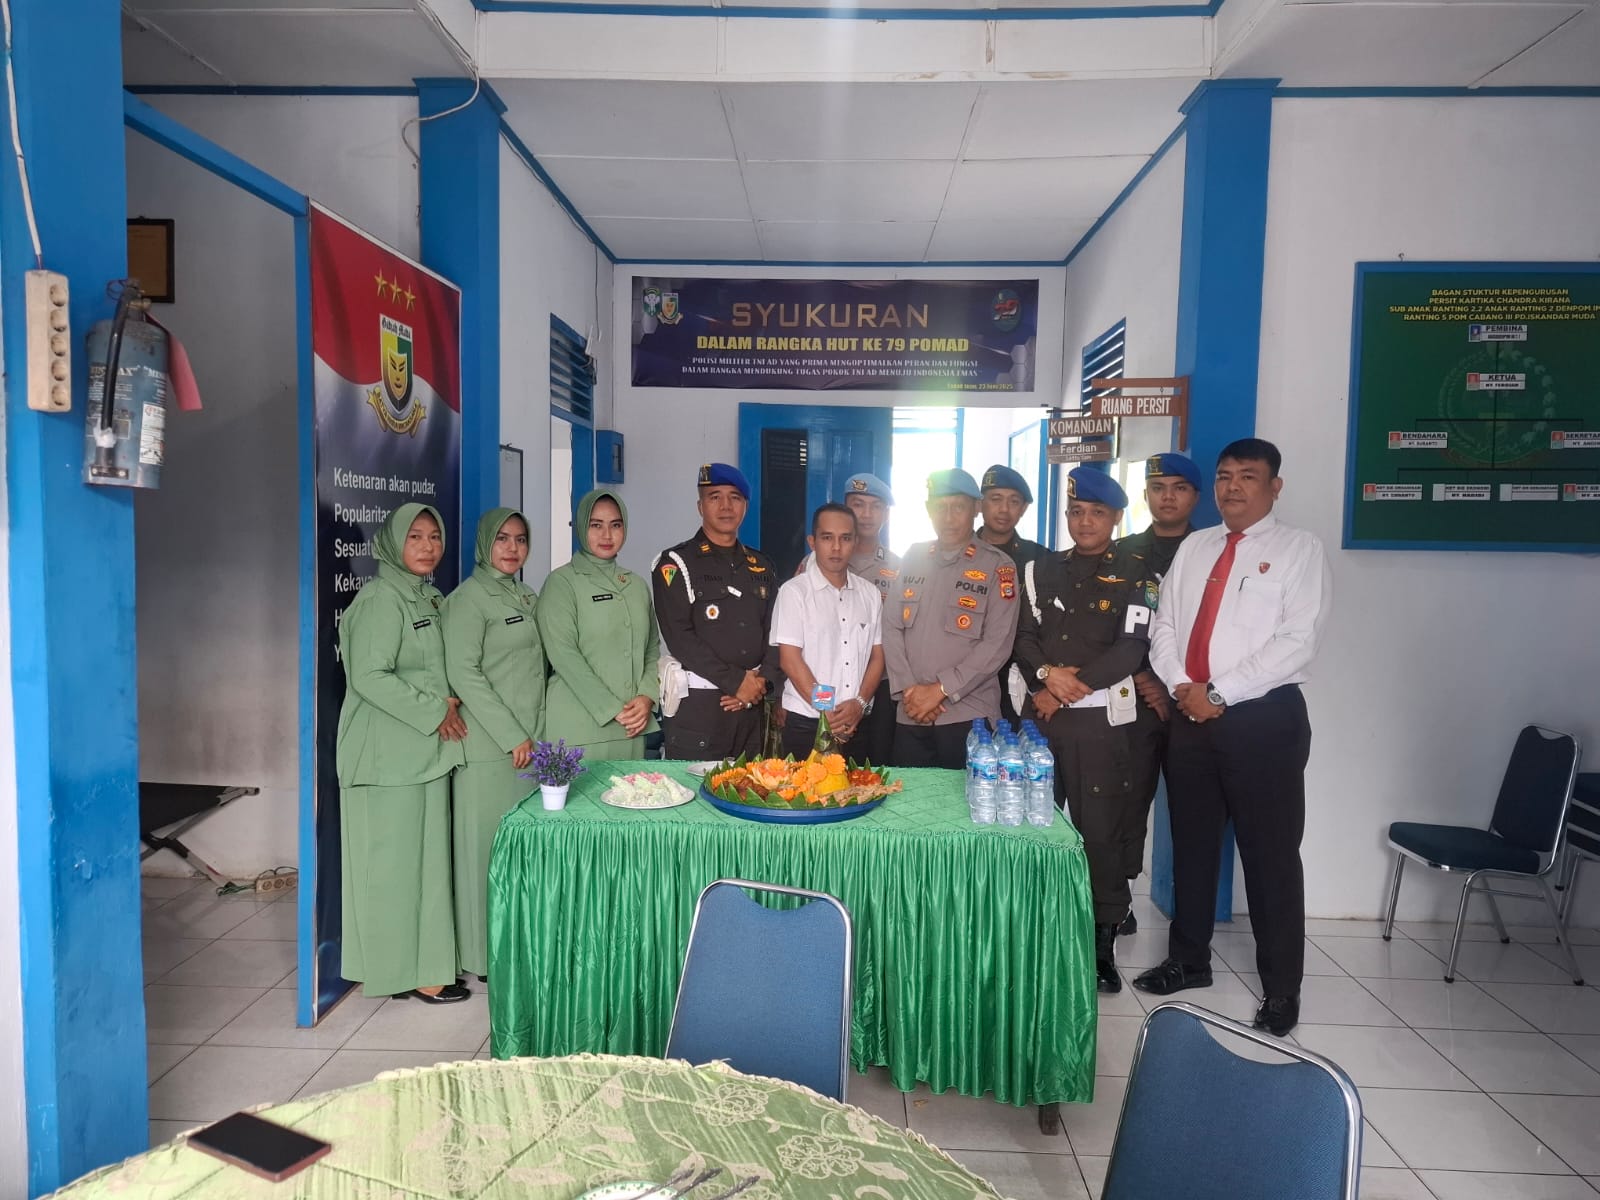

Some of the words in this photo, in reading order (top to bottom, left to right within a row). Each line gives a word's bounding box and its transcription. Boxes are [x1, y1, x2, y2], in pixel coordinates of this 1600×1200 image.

[732, 302, 929, 329] SYUKURAN
[1468, 313, 1503, 321] CABANG
[696, 335, 752, 351] DALAM
[756, 336, 823, 351] RANGKA
[826, 337, 859, 352] HUT
[862, 337, 882, 352] KE
[886, 337, 905, 352] 79
[909, 337, 969, 352] POMAD
[719, 357, 751, 365] MILITER
[767, 358, 778, 366] AD
[780, 358, 800, 366] YANG
[802, 358, 828, 366] PRIMA
[830, 359, 903, 367] MENGOPTIMALKAN
[681, 366, 709, 374] DALAM
[710, 366, 742, 374] RANGKA
[743, 367, 793, 375] MENDUKUNG
[796, 368, 821, 376] TUGAS
[822, 368, 850, 376] POKOK
[852, 368, 866, 376] TNI
[866, 368, 877, 376] AD
[879, 369, 912, 377] MENUJU
[913, 369, 955, 377] INDONESIA
[1101, 399, 1132, 416] RUANG
[1136, 397, 1172, 415] PERSIT
[1050, 418, 1112, 435] KOMANDAN
[1060, 444, 1097, 454] Ferdian
[333, 467, 387, 491] Ketenaran
[388, 475, 410, 493] akan
[411, 478, 436, 498] pudar,
[955, 580, 988, 595] POLRI
[1125, 604, 1150, 634] P
